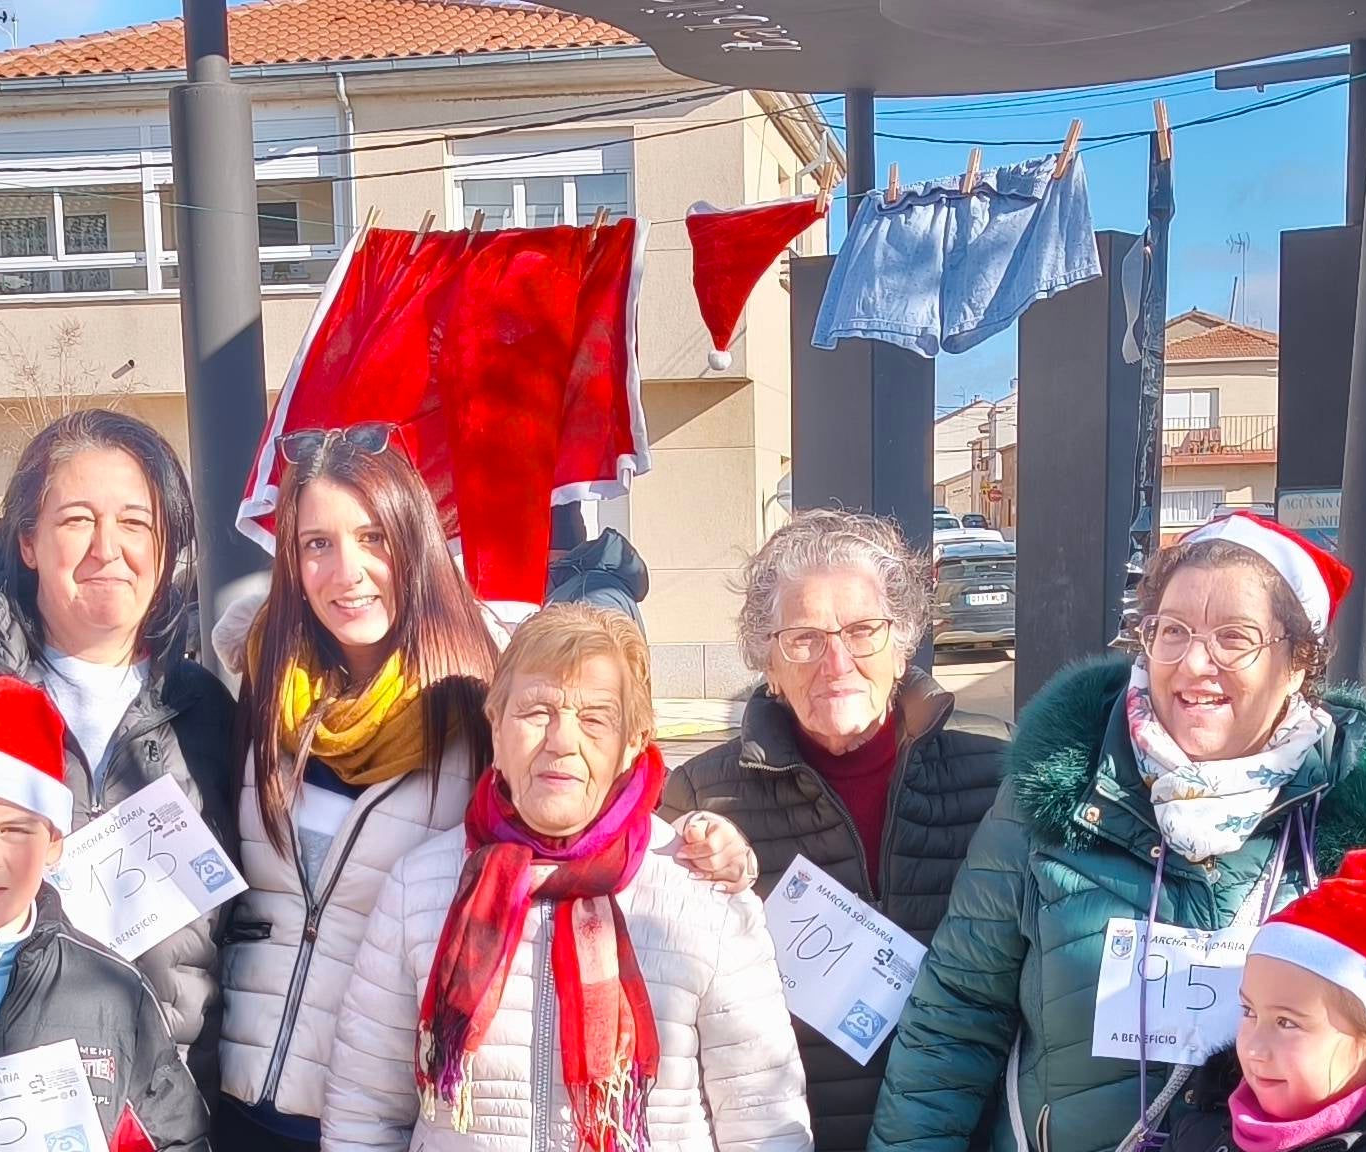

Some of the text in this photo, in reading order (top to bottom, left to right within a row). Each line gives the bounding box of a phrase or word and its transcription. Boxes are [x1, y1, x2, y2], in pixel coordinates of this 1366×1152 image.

[1316, 497, 1332, 509] SIN
[67, 831, 104, 860] MARCHA
[104, 806, 146, 839] SOLIDARIA
[89, 829, 178, 907] 133
[116, 913, 159, 947] BENEFICIO
[815, 884, 894, 945] MARCHA SOLIDARIA
[1139, 934, 1188, 948] MARCHA
[786, 913, 854, 977] 101
[1137, 954, 1223, 1011] 95
[1110, 1032, 1178, 1045] A BENEFICIO
